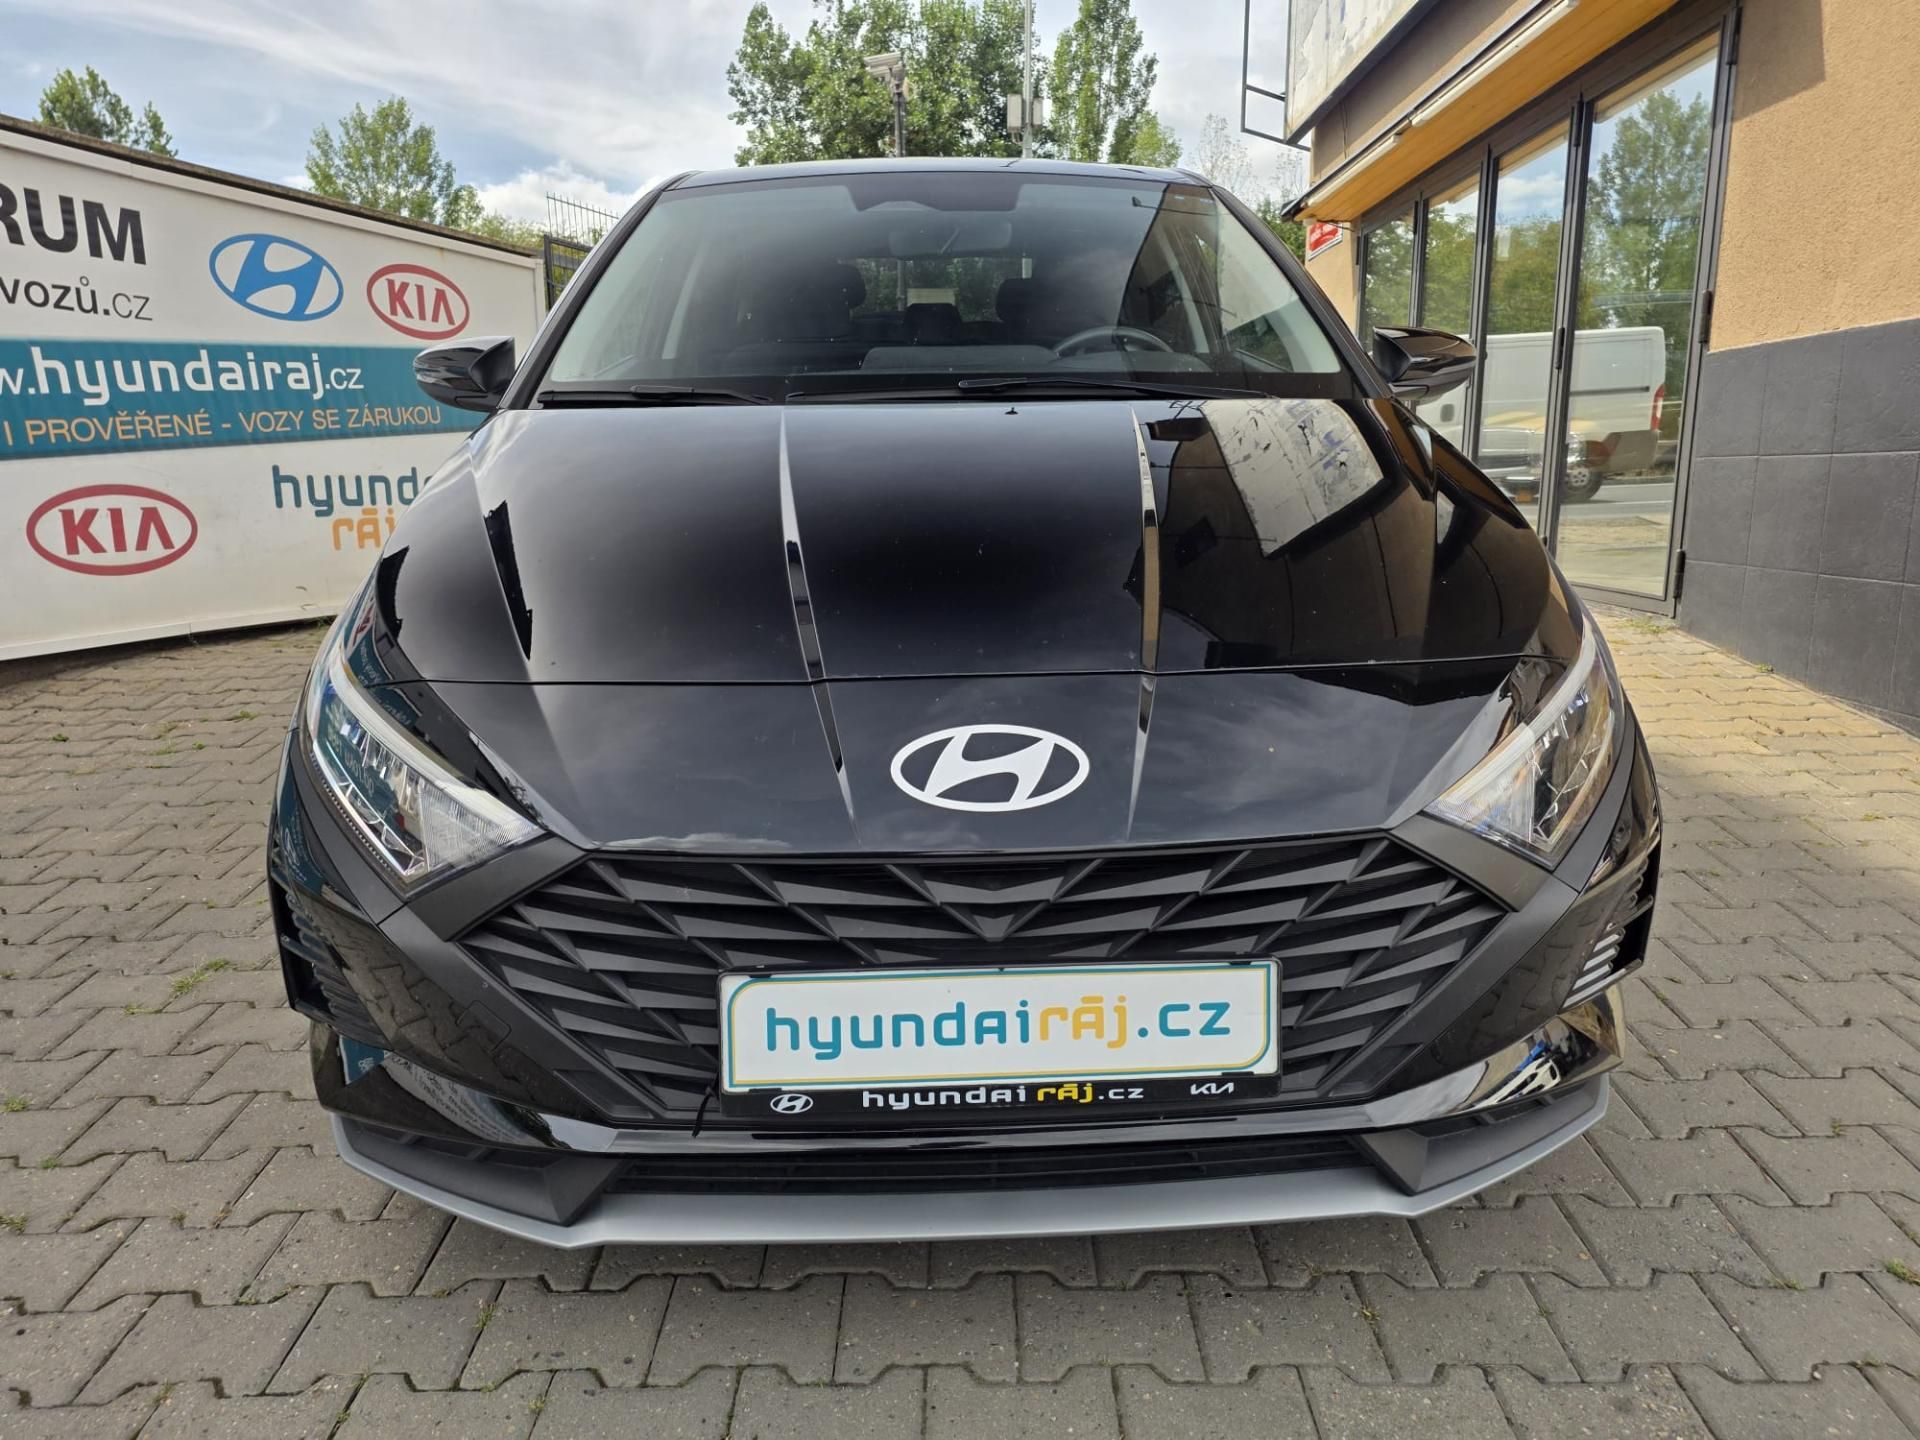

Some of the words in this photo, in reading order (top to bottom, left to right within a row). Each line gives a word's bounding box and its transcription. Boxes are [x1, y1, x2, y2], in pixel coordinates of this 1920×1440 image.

[385, 277, 456, 326] KIA
[24, 408, 213, 446] PROVĚŘENÉ
[239, 410, 304, 433] VOZY
[312, 409, 341, 430] SE
[346, 403, 441, 428] ZÁRUKOU
[272, 465, 432, 517] hyund
[58, 506, 176, 556] KIA
